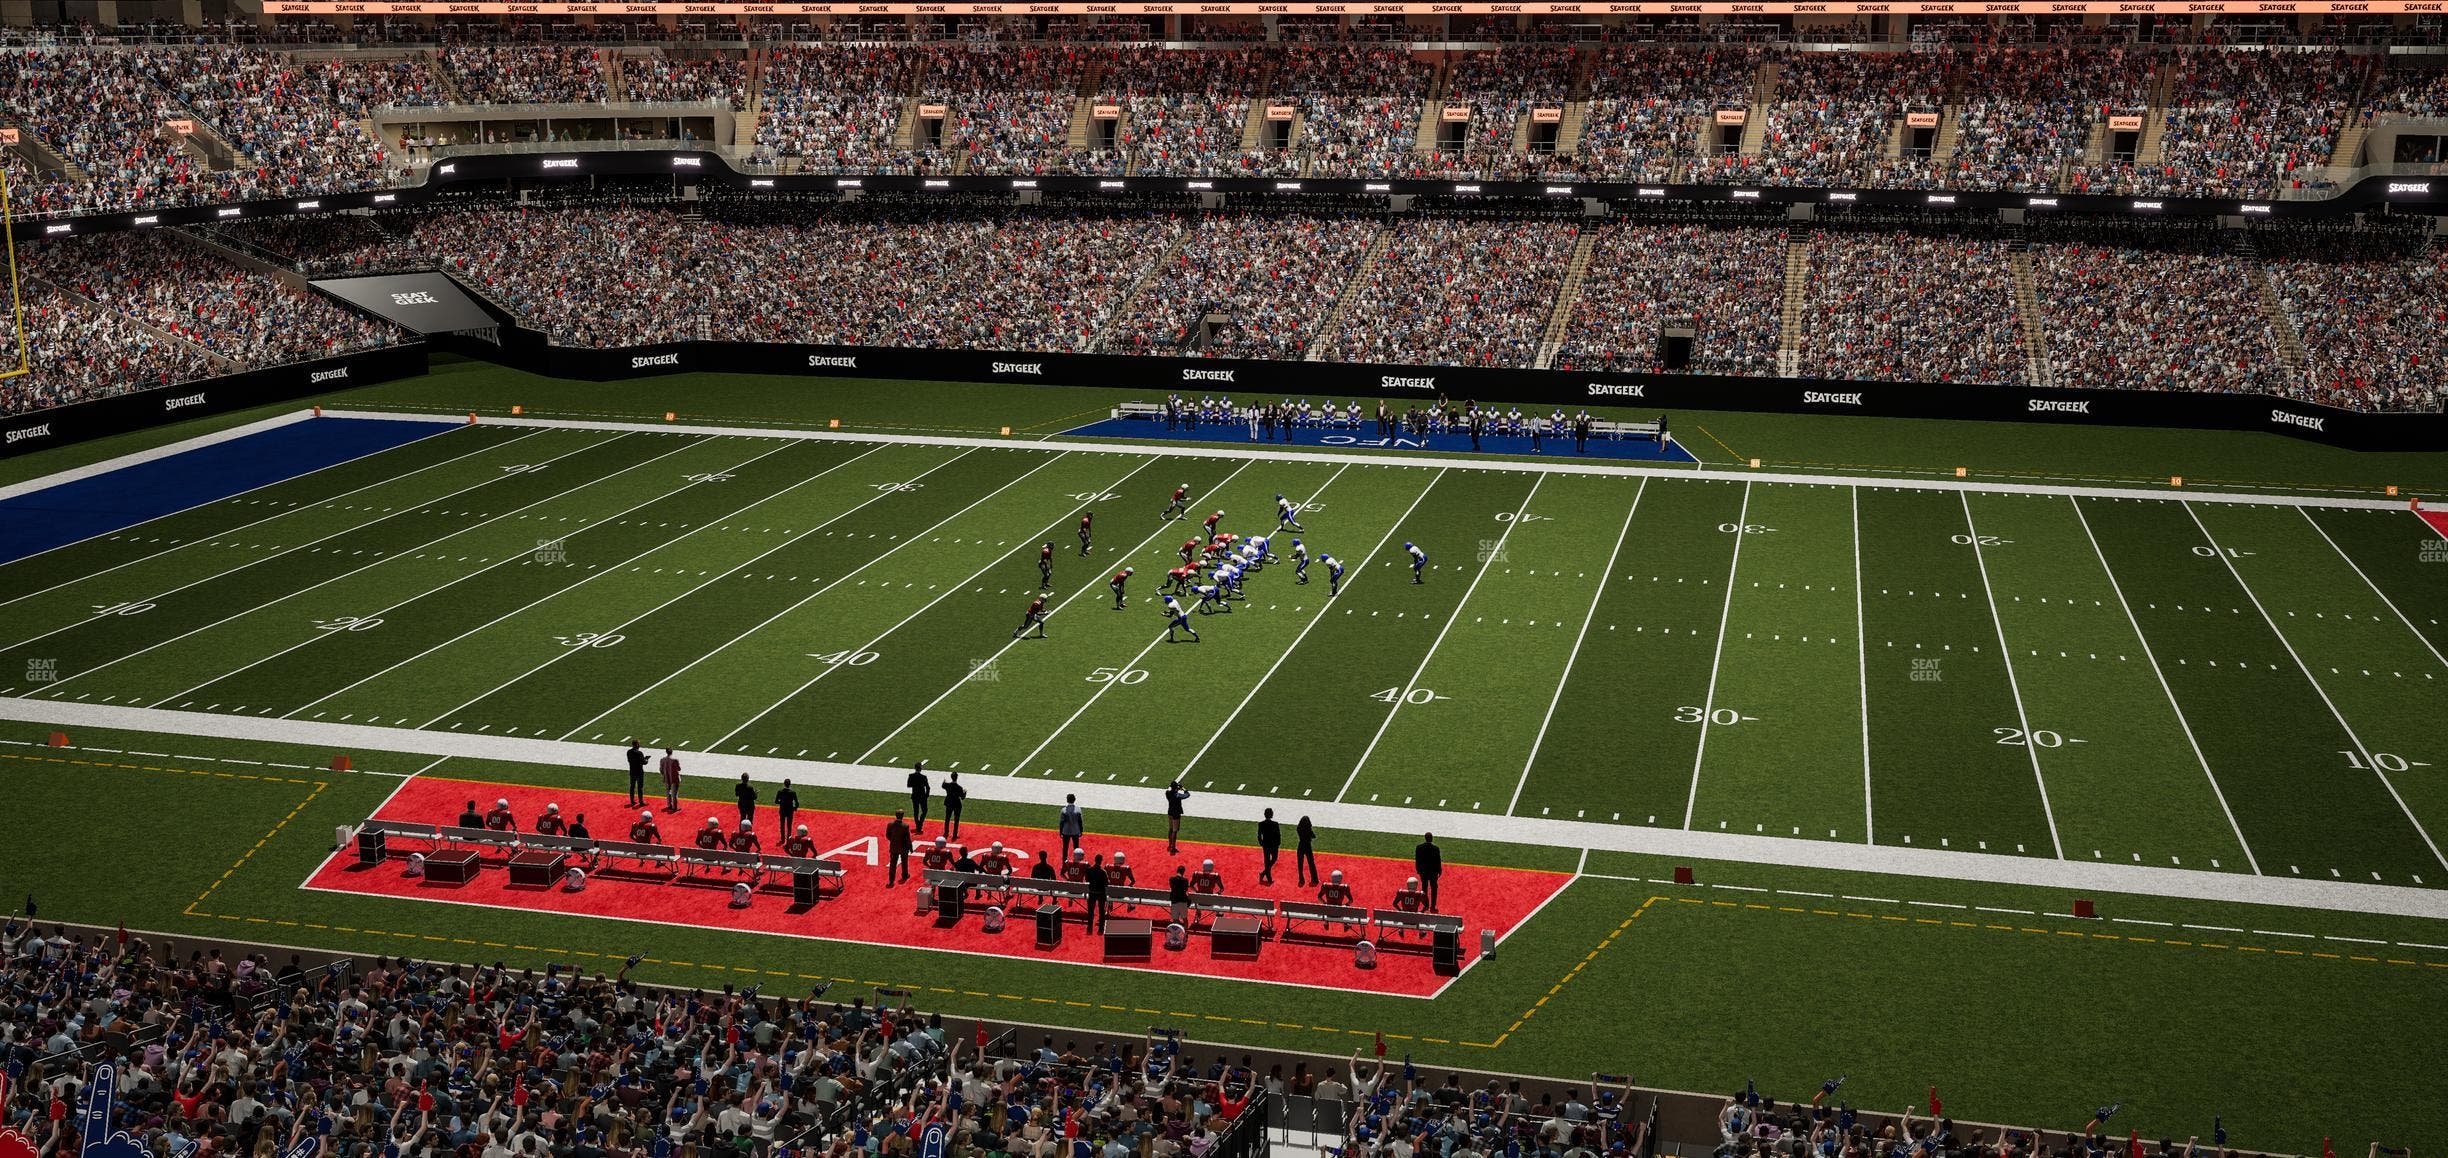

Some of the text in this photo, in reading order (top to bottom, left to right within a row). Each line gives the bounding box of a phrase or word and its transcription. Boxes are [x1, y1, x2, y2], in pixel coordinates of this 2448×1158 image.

[542, 158, 578, 169] SEATGEEK
[674, 157, 700, 167] SEATGEEK
[752, 179, 774, 187] SEATGEEK
[838, 179, 862, 187] SEATGEEK
[1456, 184, 1480, 192] SEATGEEK
[2388, 182, 2430, 193] SEATGEEK
[1546, 186, 1572, 194] SEATGEEK
[1640, 188, 1664, 196] SEATGEEK
[1734, 190, 1760, 198] SEATGEEK
[1830, 192, 1856, 201] SEATGEEK
[1928, 195, 1956, 203] SEATGEEK
[2030, 198, 2058, 206] SEATGEEK
[2134, 201, 2162, 209] SEATGEEK
[2240, 204, 2270, 213] SEATGEEK
[46, 223, 72, 234] SEATGEEK
[390, 291, 428, 300] SEAT
[394, 296, 438, 306] GEEK
[632, 353, 679, 368] SEATGEEK
[808, 355, 857, 368] SEATGEEK
[992, 361, 1042, 375] SEATGEEK
[311, 366, 348, 383] SEATGEEK
[1182, 368, 1235, 382] SEATGEEK
[1381, 376, 1435, 390] SEATGEEK
[1588, 384, 1644, 398] SEATGEEK
[166, 392, 206, 411] SEATGEEK
[1804, 390, 1862, 405] SEATGEEK
[2028, 400, 2090, 414] SEATGEEK
[2271, 410, 2325, 432] SEATGEEK
[6, 422, 50, 444] SEATGEEK
[877, 482, 925, 492] 30
[1075, 492, 1122, 502] 40
[1494, 512, 1544, 523] 40
[1718, 523, 1764, 535] 30
[1951, 534, 1999, 547] 20
[2192, 546, 2240, 558] 10
[100, 601, 157, 616] 10
[318, 616, 385, 632] 20
[560, 632, 626, 649] 30
[816, 649, 880, 666] 40
[1085, 666, 1150, 685] 50
[1369, 686, 1436, 706] 40
[1673, 705, 1739, 727] 30
[1993, 726, 2064, 749] 20
[2337, 749, 2409, 773] 10
[492, 816, 500, 824] 00
[542, 821, 551, 829] 00
[636, 829, 646, 837] 00
[702, 835, 712, 844] 00
[736, 838, 745, 846] 00
[932, 855, 940, 863] 00
[988, 860, 997, 868] 00
[1200, 878, 1210, 886] 00
[1328, 890, 1338, 898] 00
[1404, 897, 1414, 905] 00
